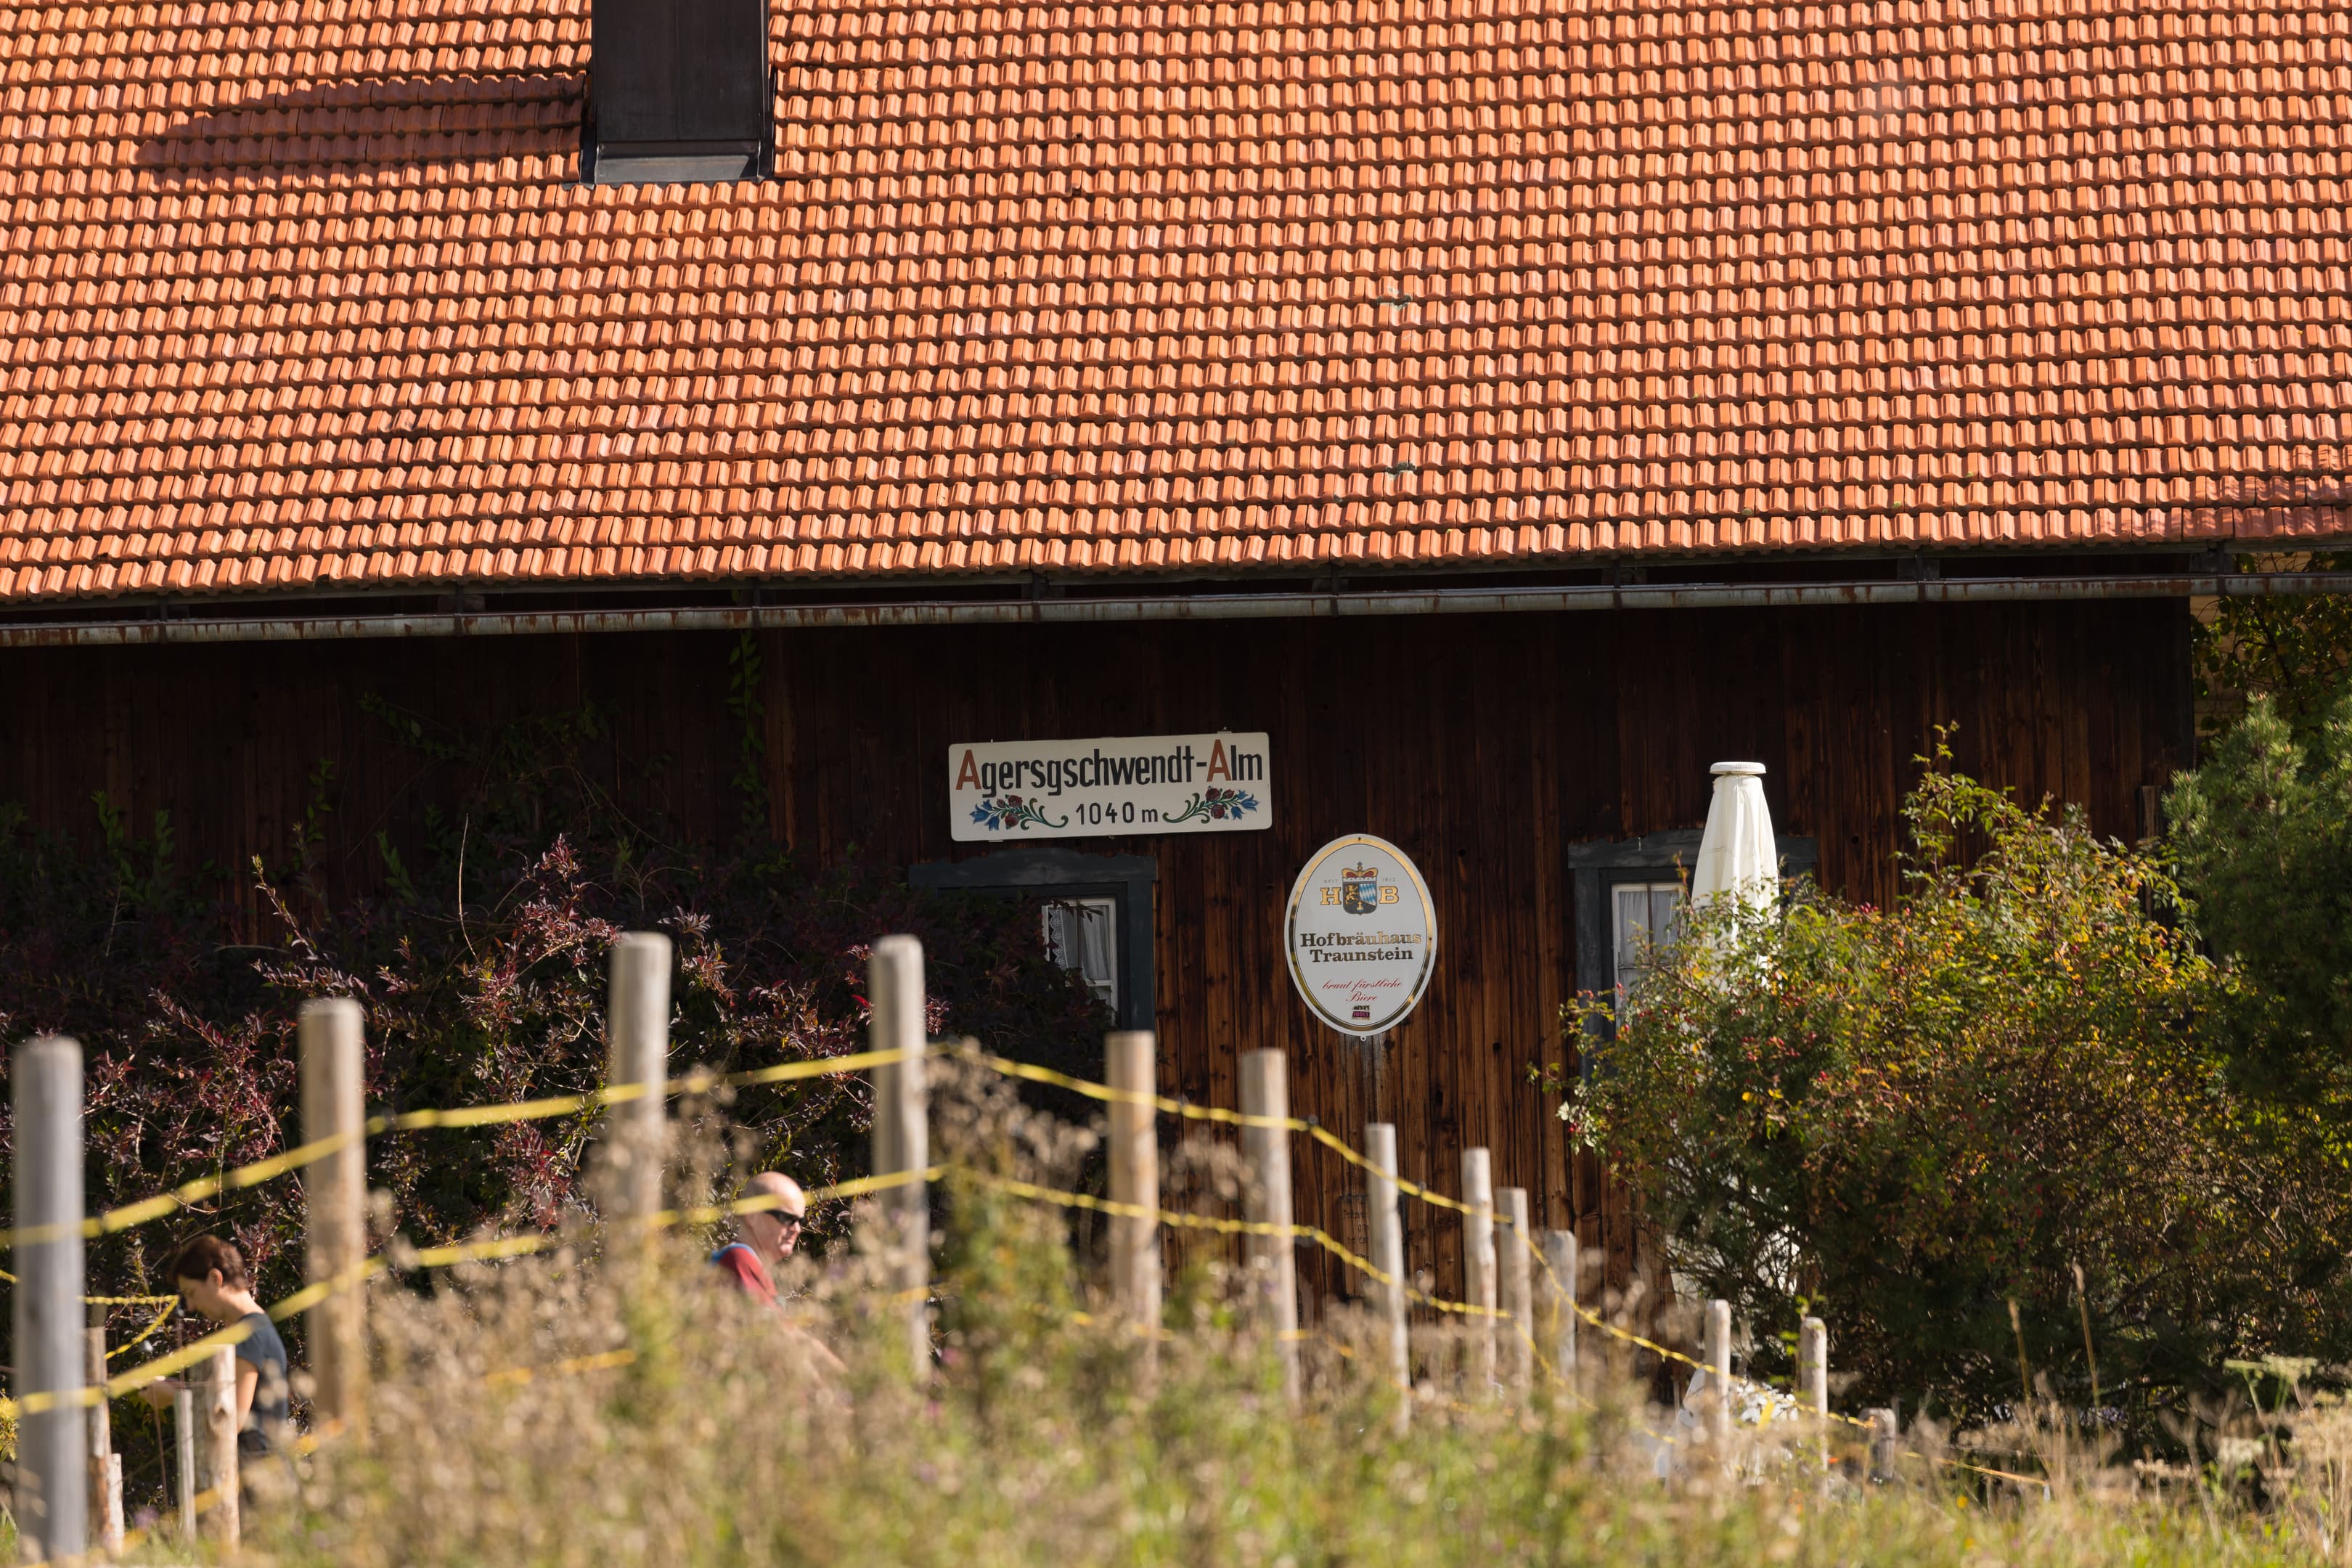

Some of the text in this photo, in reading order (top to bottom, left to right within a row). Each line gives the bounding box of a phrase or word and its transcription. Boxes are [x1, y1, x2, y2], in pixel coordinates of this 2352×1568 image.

[955, 739, 1262, 799] Agersgschwendt-Alm
[1075, 801, 1159, 825] 1040 m
[1300, 931, 1422, 947] Hofbräuhaus
[1310, 947, 1413, 963] Traunstein
[1346, 991, 1377, 1002] Biere
